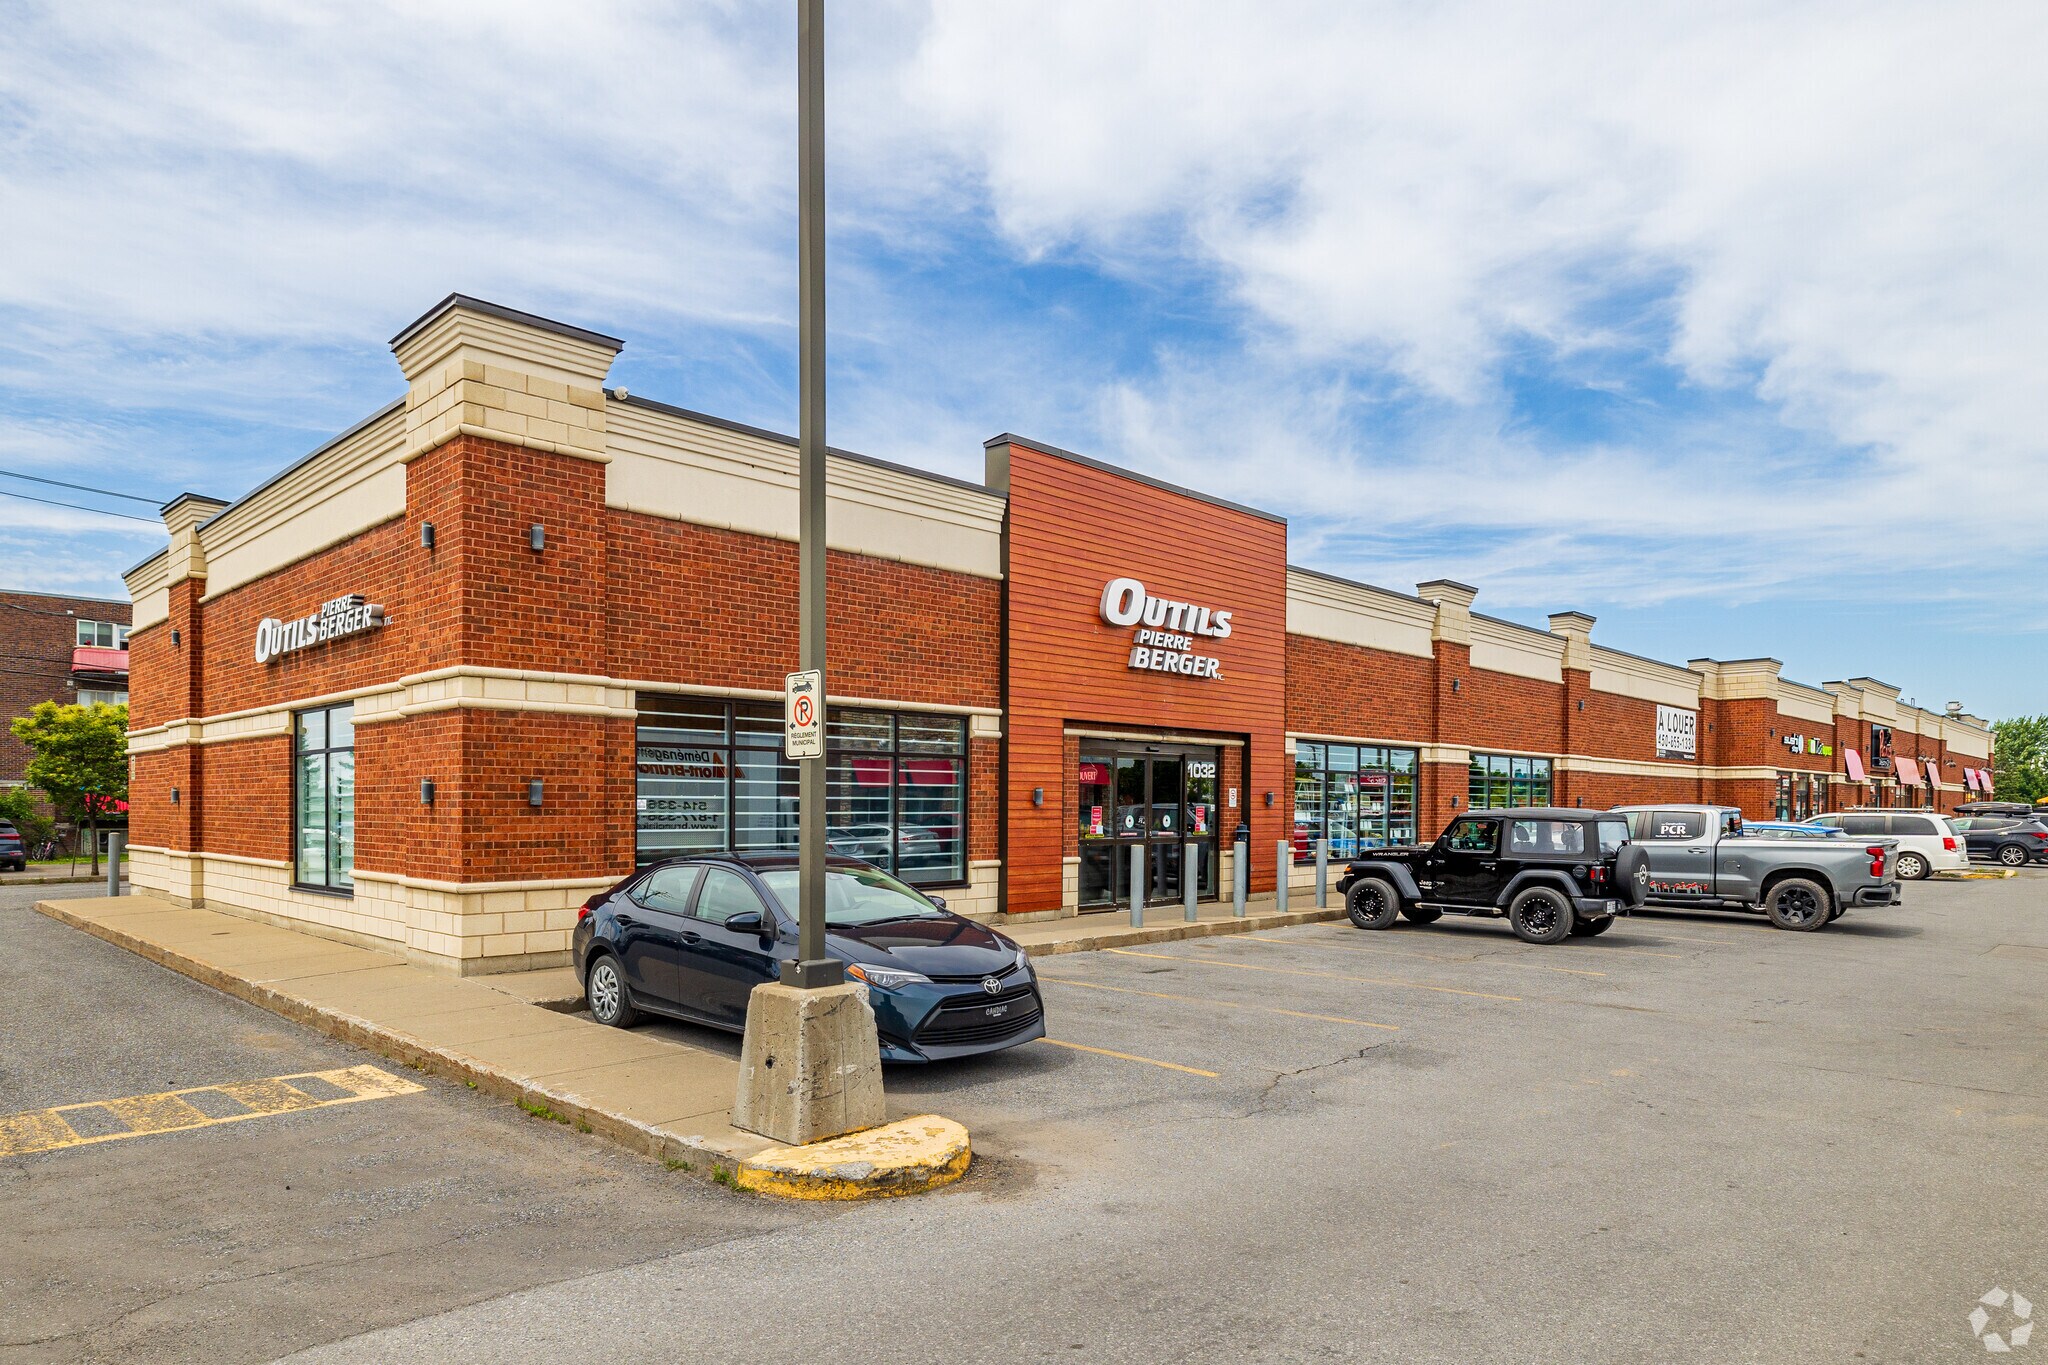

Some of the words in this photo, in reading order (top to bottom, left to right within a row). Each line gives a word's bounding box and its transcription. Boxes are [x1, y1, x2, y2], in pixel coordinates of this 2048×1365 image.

[320, 593, 356, 618] PIERRE
[1101, 577, 1232, 638] OUTILS
[319, 604, 374, 641] BERGER
[255, 613, 320, 664] OUTILS
[1136, 629, 1193, 651] PIERRE
[1130, 646, 1220, 679] BERGER
[1667, 712, 1694, 736] LOUER
[1188, 763, 1216, 779] 1032
[1660, 825, 1686, 835] PCR
